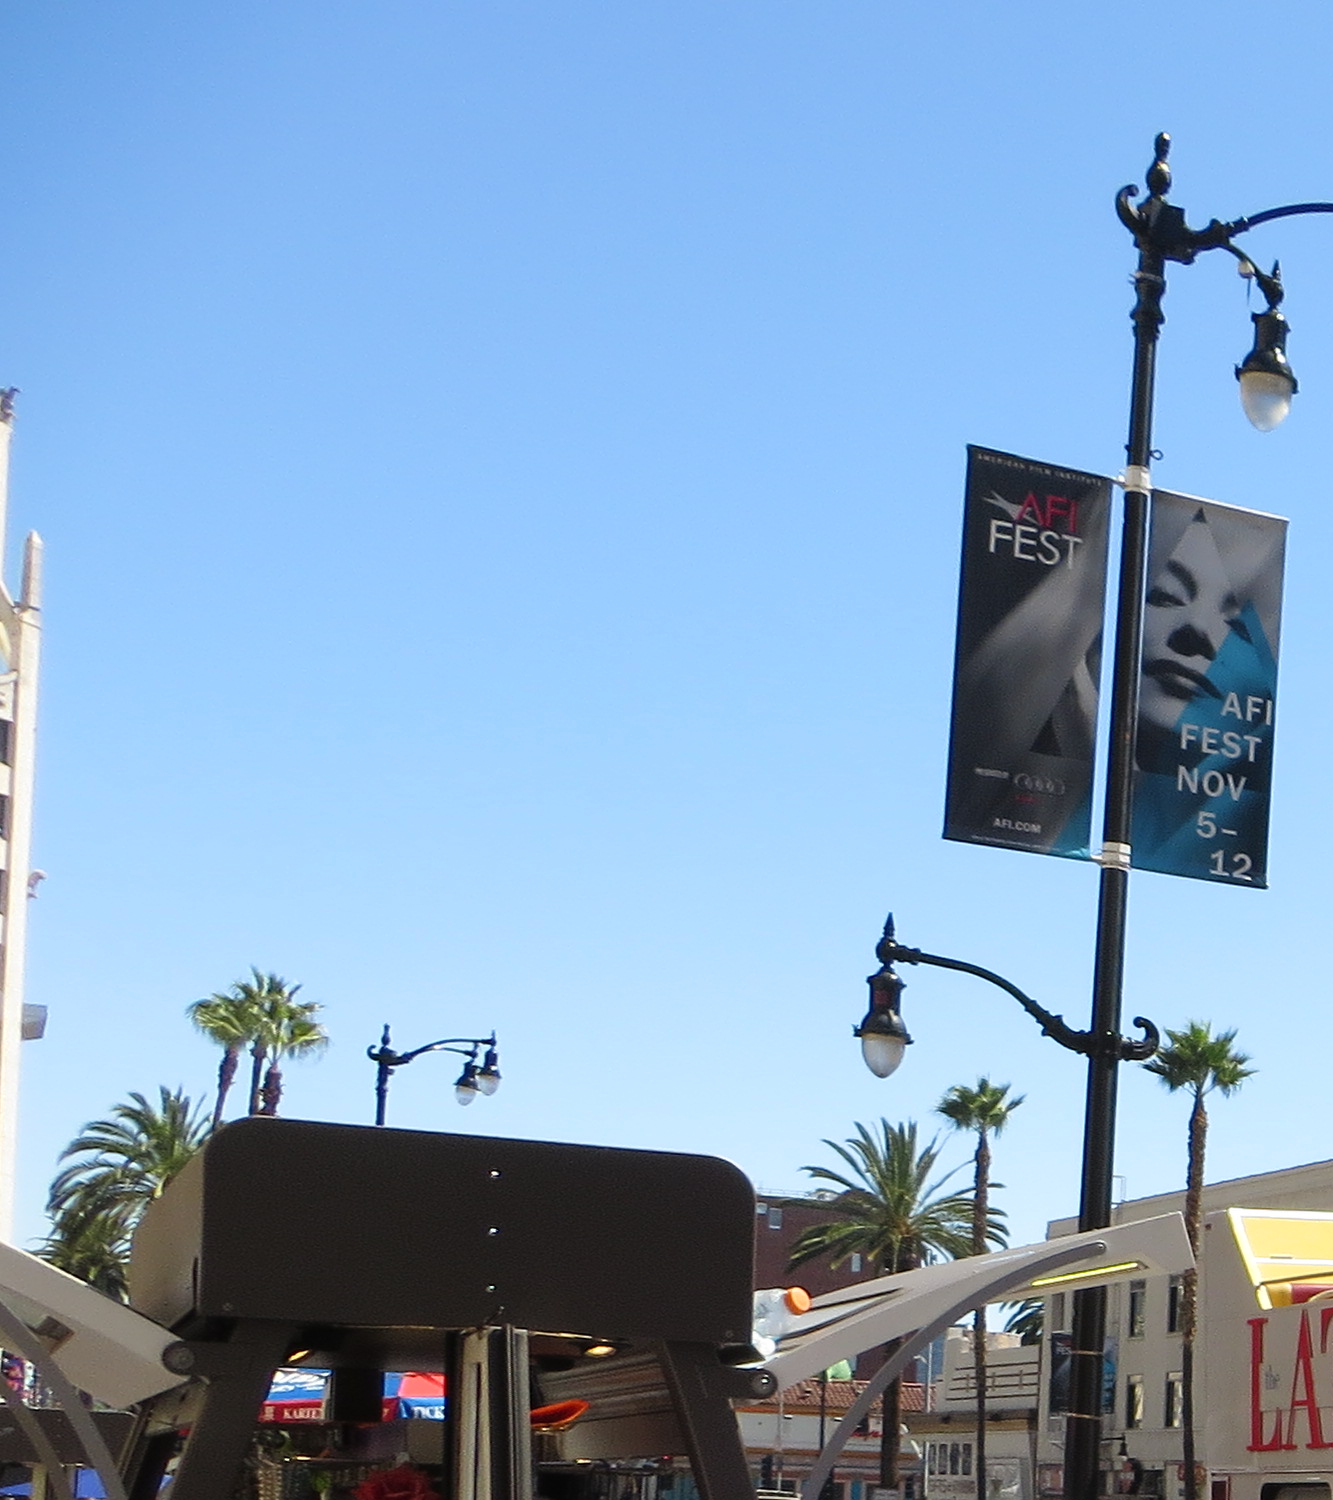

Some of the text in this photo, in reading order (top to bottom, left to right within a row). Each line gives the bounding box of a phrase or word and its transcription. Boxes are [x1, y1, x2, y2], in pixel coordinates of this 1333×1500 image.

[978, 453, 1025, 470] AMERICAN
[1029, 464, 1051, 476] FILM
[1016, 493, 1078, 533] AFI
[988, 518, 1083, 570] FEST
[1220, 691, 1273, 726] AFI
[1181, 724, 1263, 763] FEST
[1177, 764, 1247, 800] NOV
[993, 818, 1042, 834] AFI.COM
[1209, 853, 1253, 882] 12
[411, 1406, 445, 1419] TICK
